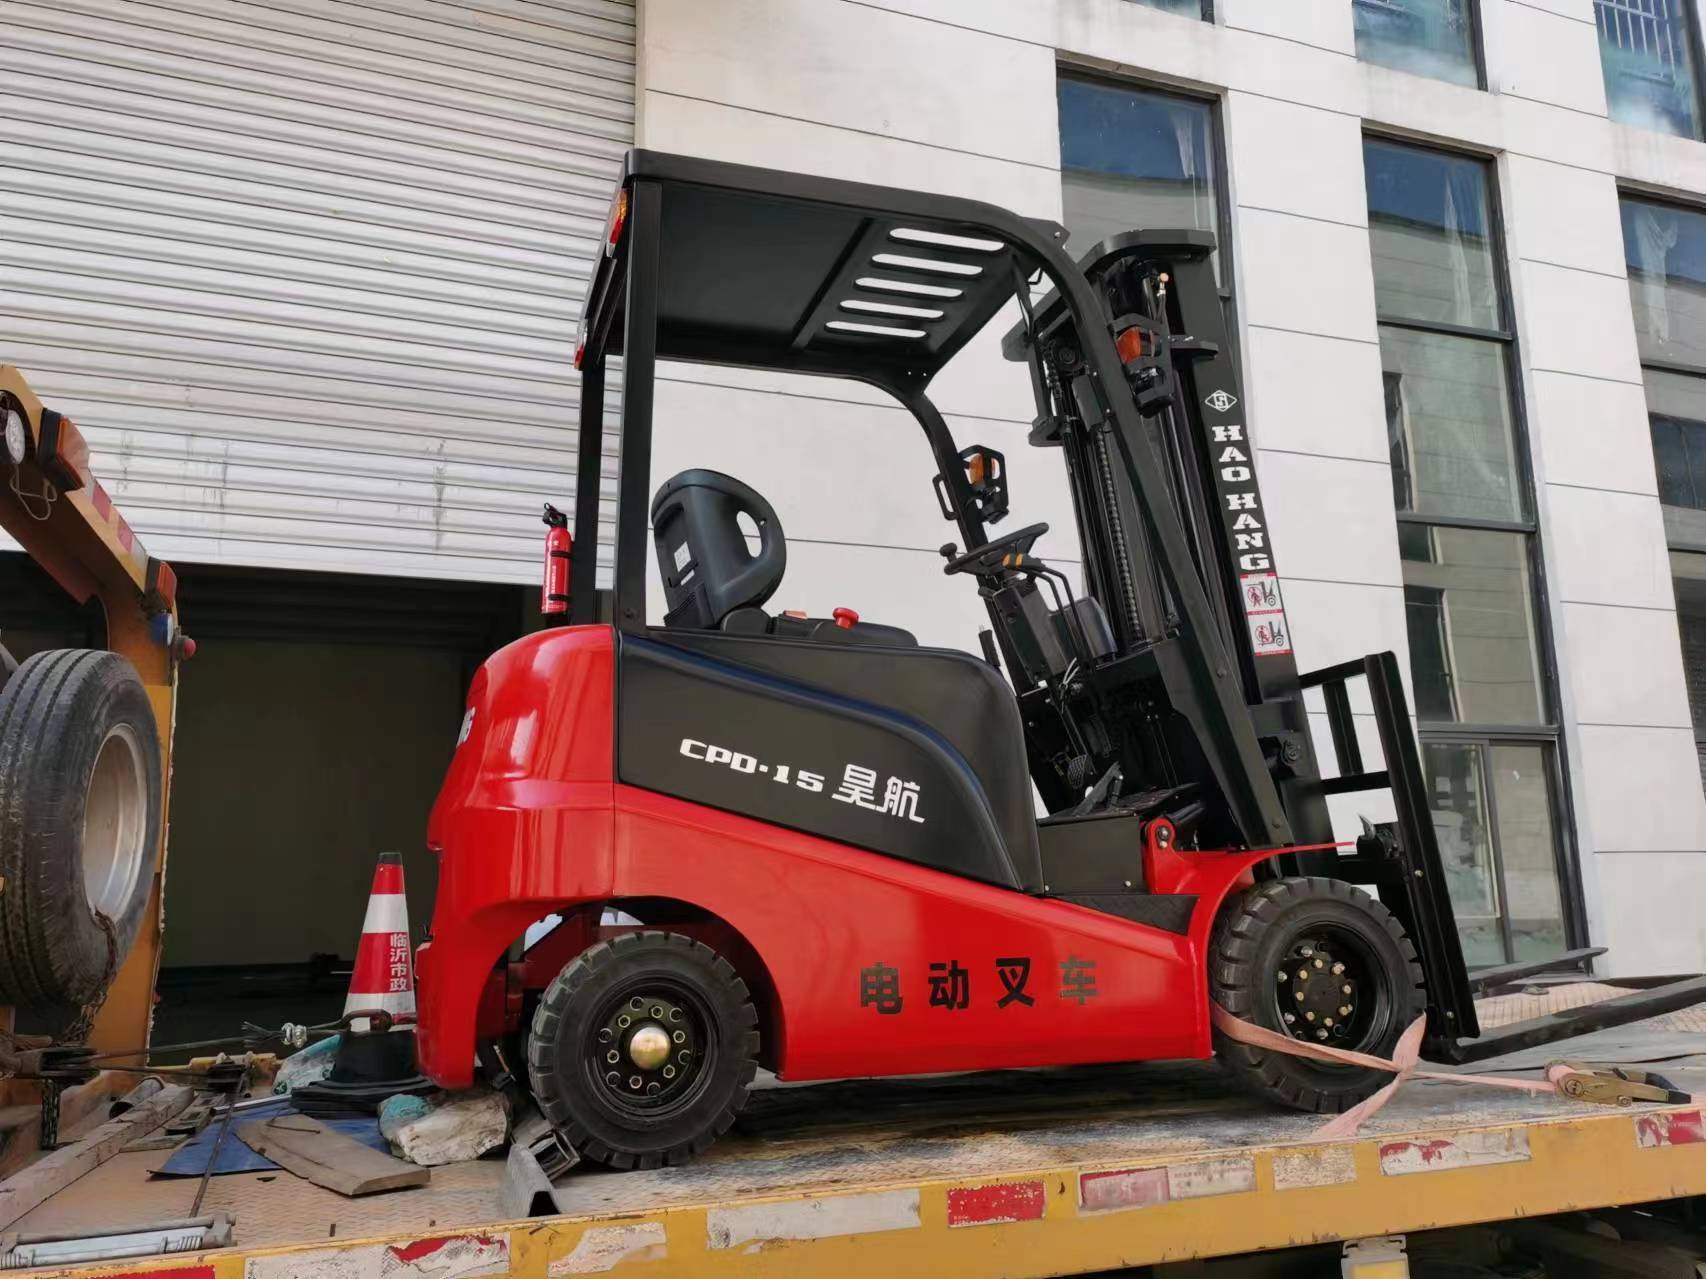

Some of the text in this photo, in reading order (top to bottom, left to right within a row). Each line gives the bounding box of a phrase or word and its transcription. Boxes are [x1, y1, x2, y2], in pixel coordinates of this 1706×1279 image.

[1212, 425, 1251, 482] HAO
[1225, 493, 1270, 571] HANG
[831, 763, 925, 824] 昊航
[390, 933, 408, 992] 临沂市政
[860, 955, 1098, 1014] 电动叉车
